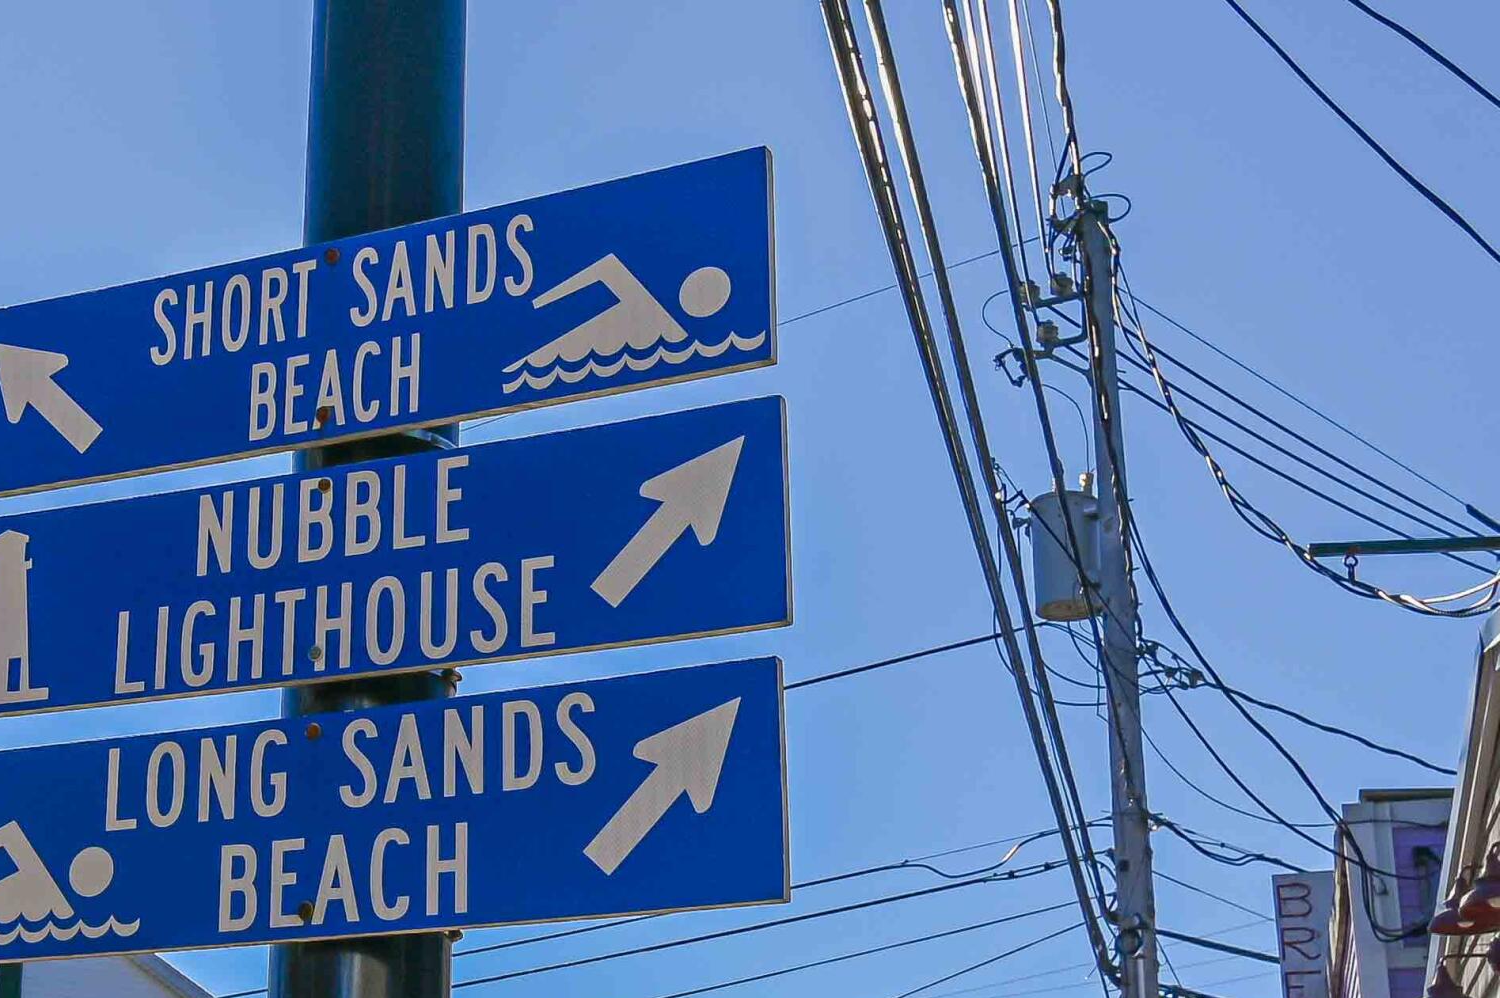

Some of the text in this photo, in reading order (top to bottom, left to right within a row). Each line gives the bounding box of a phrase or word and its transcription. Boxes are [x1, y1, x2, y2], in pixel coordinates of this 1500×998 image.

[150, 214, 535, 366] SHORT SANDS
[248, 332, 422, 442] BEACH
[196, 454, 471, 577] NUBBLE
[114, 555, 557, 694] LIGHTHOUSE
[105, 692, 597, 832] LONG SANDS
[218, 822, 469, 933] BEACH
